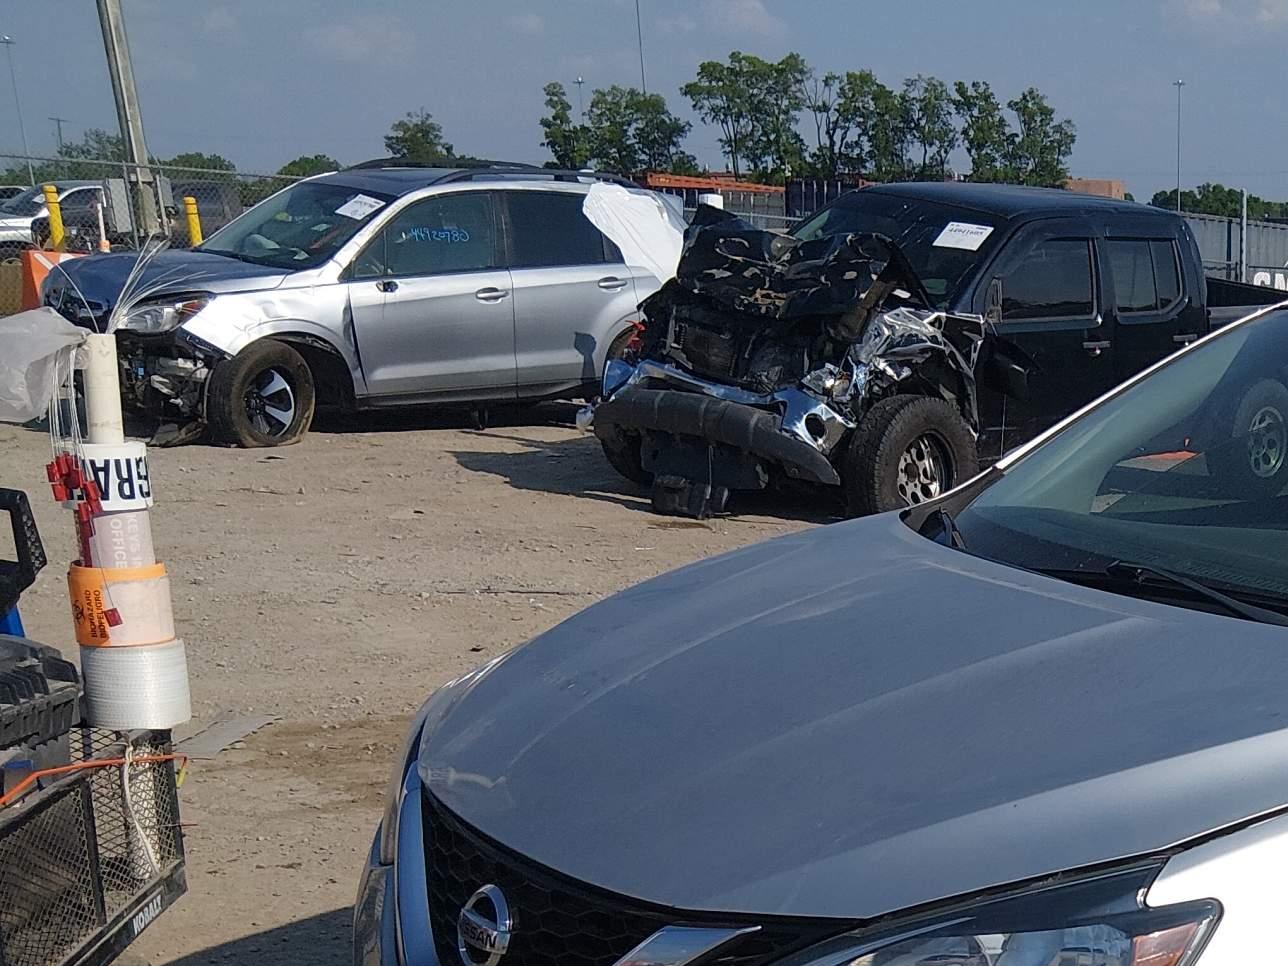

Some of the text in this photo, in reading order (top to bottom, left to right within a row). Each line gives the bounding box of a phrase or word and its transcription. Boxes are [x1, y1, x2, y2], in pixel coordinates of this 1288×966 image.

[110, 518, 127, 568] OFFICE
[84, 589, 98, 638] BIOHAZARD
[93, 589, 107, 639] BIOPELIGRO
[132, 894, 163, 937] KOBALT
